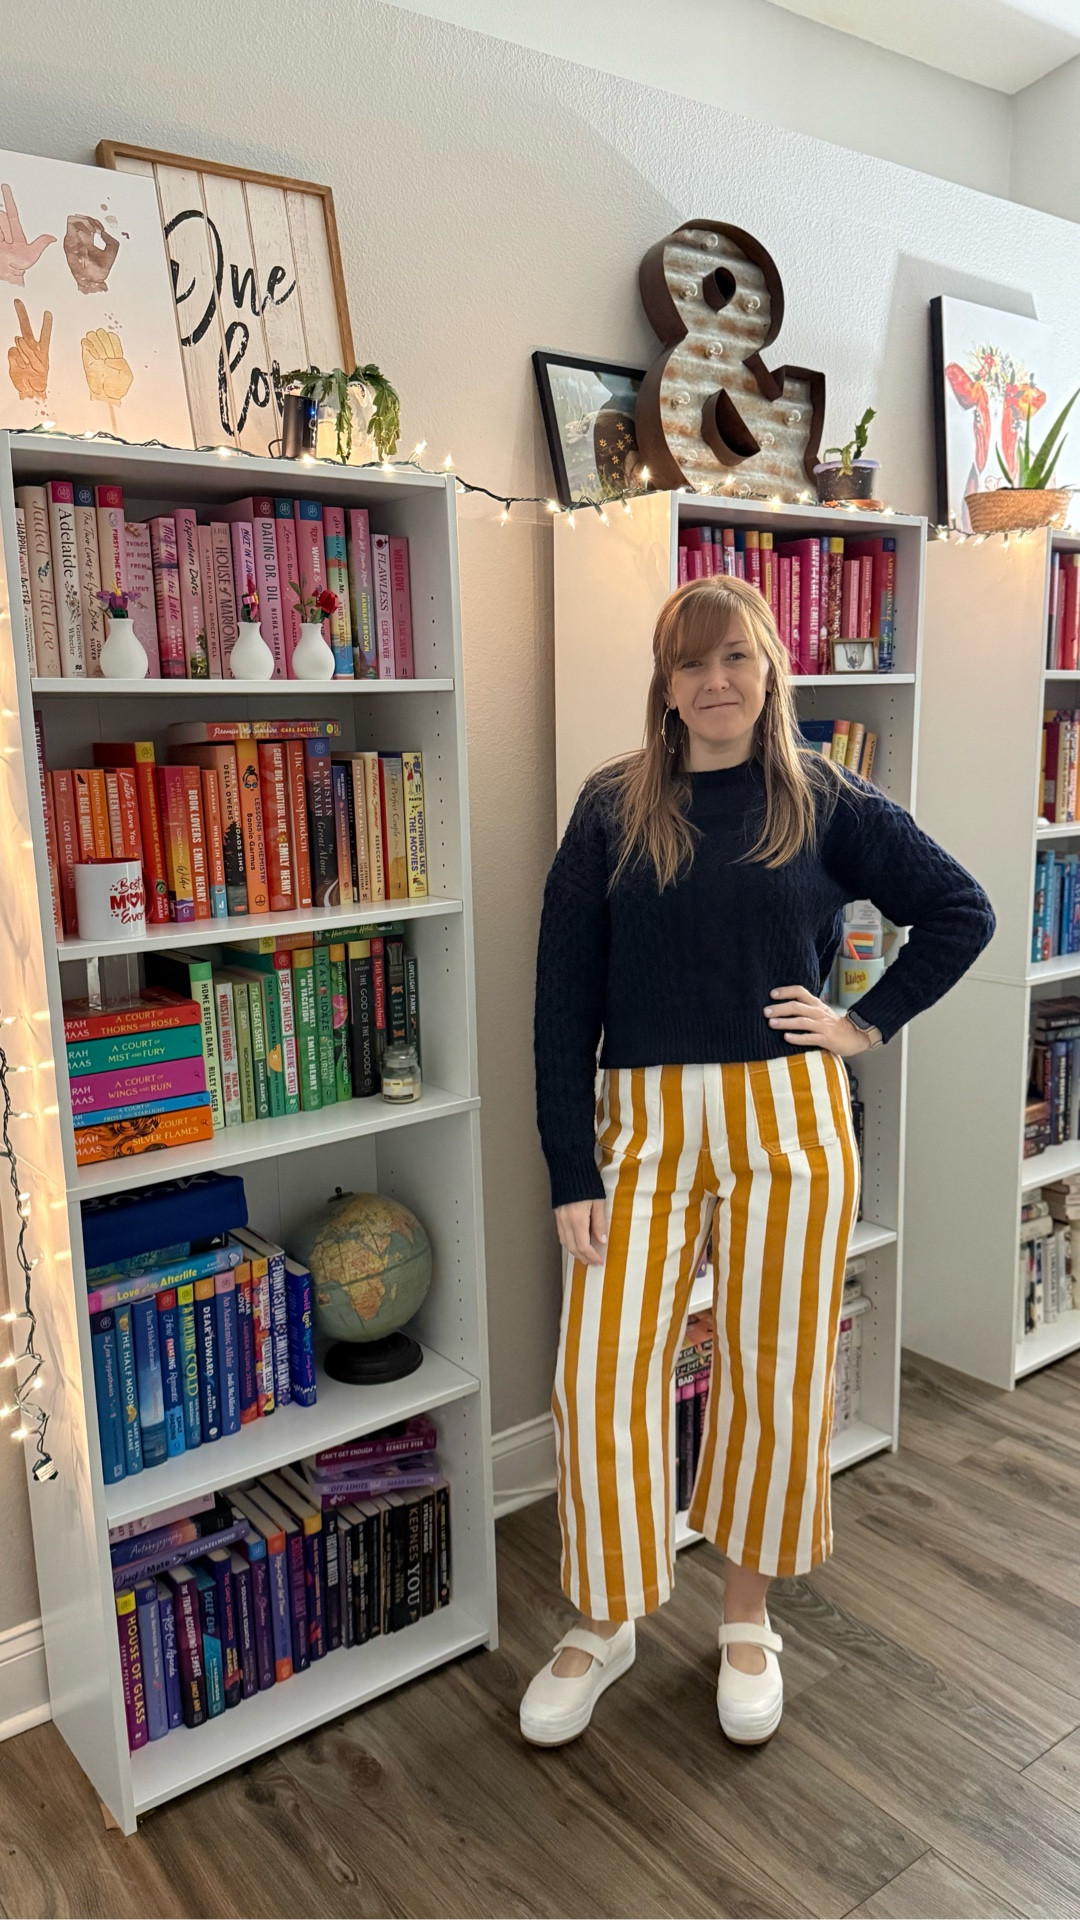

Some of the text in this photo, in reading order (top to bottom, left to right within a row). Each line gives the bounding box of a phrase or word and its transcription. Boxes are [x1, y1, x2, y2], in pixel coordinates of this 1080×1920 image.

[164, 209, 297, 348] One
[58, 508, 76, 578] Adelaide
[184, 519, 199, 596] Expiration Dates
[261, 522, 275, 560] DATING
[32, 501, 56, 650] Jaded Ela Lee
[265, 564, 276, 581] DR.
[266, 586, 278, 602] DIL
[377, 552, 390, 659] FLAWLESS ELSIE SILVER
[810, 606, 818, 631] EMILY
[273, 633, 281, 661] SHARMA
[362, 625, 370, 652] BROWN
[810, 635, 818, 660] HENRY
[59, 777, 67, 792] THE
[312, 771, 322, 817] HANNAH
[323, 771, 332, 816] KRISTIN
[225, 791, 233, 821] OWENS
[254, 798, 263, 832] LESSONS
[294, 752, 308, 852] The Correspondent
[63, 820, 71, 841] LOVE
[233, 805, 242, 850] CRAWDADS
[273, 748, 291, 895] GREAT BIG BEAUTIFUL LIFE EMILY HENRY
[188, 789, 207, 903] BOOK LOVERS EMILY HENRY
[317, 821, 328, 876] Great Alone
[410, 835, 418, 871] MOVIES
[65, 844, 75, 889] DECEPTION
[215, 859, 223, 882] ROME
[258, 843, 266, 885] CHEMISTRY
[117, 876, 141, 894] Best
[201, 983, 209, 1004] HOME
[375, 976, 383, 987] Me
[253, 1002, 262, 1027] CHEAT
[360, 988, 370, 1010] GOD
[376, 988, 384, 1027] Everything
[101, 1023, 139, 1035] THORNS
[151, 1017, 180, 1028] ROSES
[125, 1011, 156, 1021] COURT
[203, 1007, 212, 1036] BEFORE
[219, 994, 232, 1061] KRISTAN HIGGINS
[362, 1013, 370, 1023] OF
[122, 1039, 153, 1050] COURT
[206, 1037, 214, 1058] DARK
[254, 1029, 264, 1053] SHEET
[281, 973, 296, 1094] THE LOVE HATERS KATHERINE CENTER
[108, 1052, 130, 1063] MIST
[143, 1047, 165, 1058] FURY
[320, 1046, 328, 1079] LAUREN
[363, 1039, 371, 1075] WOODS
[108, 1087, 138, 1099] WINGS
[151, 1082, 172, 1092] RUIN
[125, 1076, 156, 1087] COURT
[309, 1064, 317, 1090] HENRY
[210, 1089, 218, 1112] SAGER
[132, 1127, 199, 1146] SILVER FLAMES
[117, 1269, 197, 1300] Love Afterlife
[146, 1310, 157, 1371] Elin Hilderbrand
[184, 1317, 195, 1350] KILLING
[203, 1306, 213, 1376] DEAR EDWARD
[273, 1265, 289, 1391] FUNNY STORY EMILY HENRY
[122, 1331, 134, 1408] THE HALF MOON
[185, 1353, 198, 1396] COLD
[321, 1452, 337, 1460] CAN'T
[350, 1447, 373, 1455] ENOUGH
[407, 1507, 420, 1606] KEPNES YOU
[204, 1591, 215, 1633] DEEP END
[126, 1616, 145, 1724] HOUSE OF GLASS
